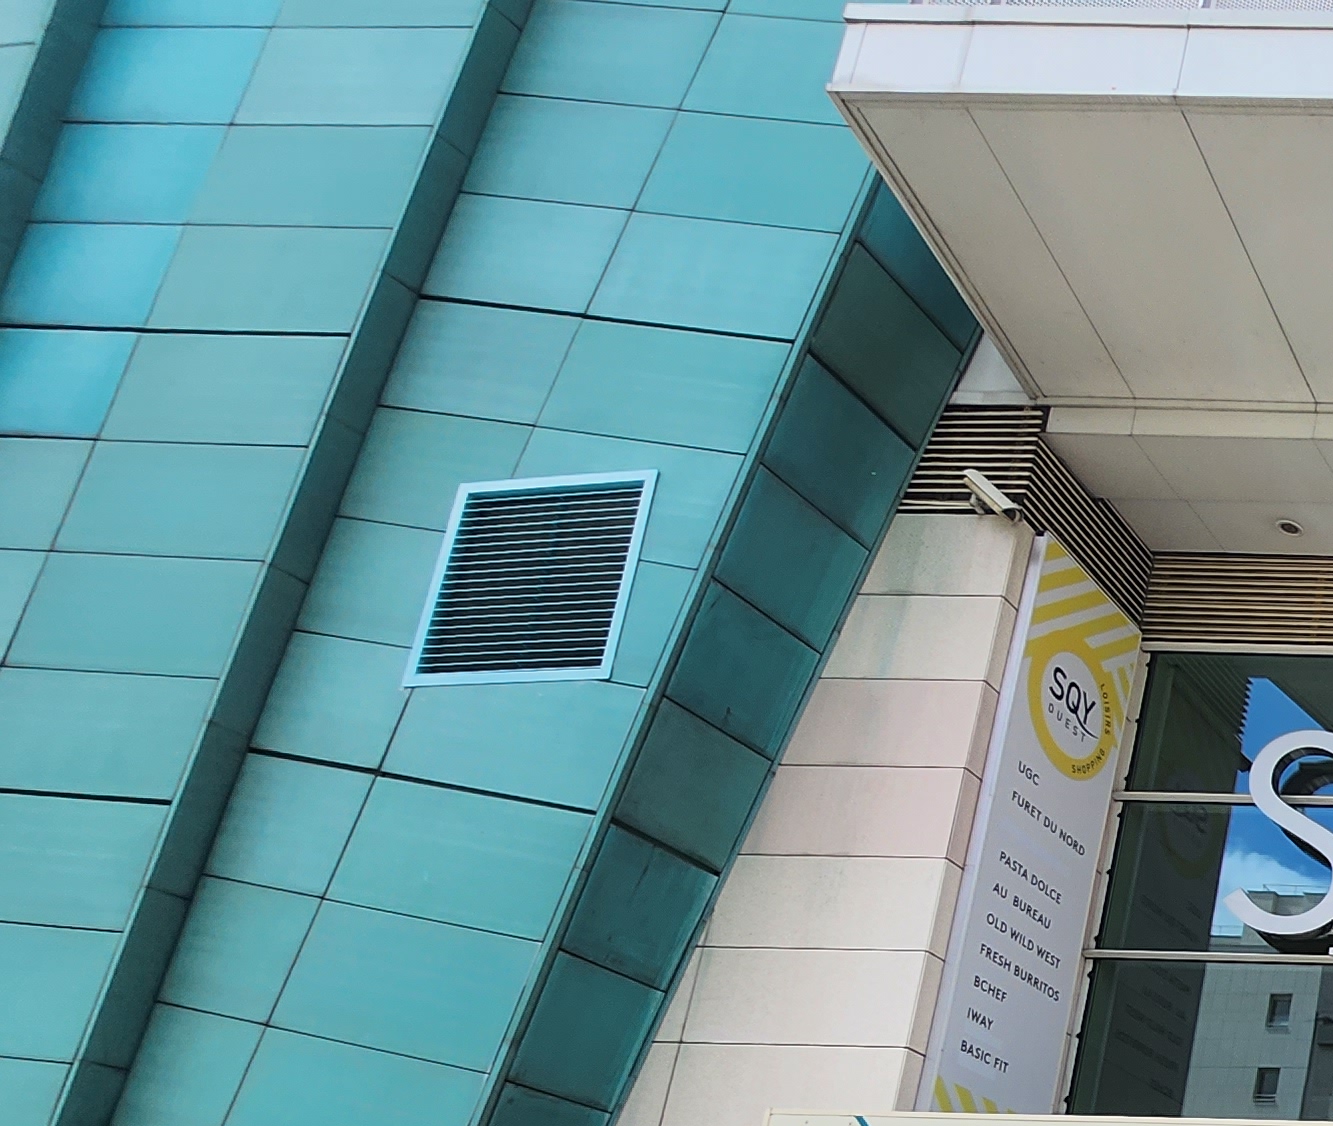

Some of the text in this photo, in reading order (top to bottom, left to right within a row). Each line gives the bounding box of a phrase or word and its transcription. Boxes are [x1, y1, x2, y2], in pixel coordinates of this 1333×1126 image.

[1048, 666, 1099, 740] SQY
[1048, 702, 1086, 742] OUEST
[1100, 683, 1112, 735] LOISIRS
[1018, 761, 1040, 787] UGC
[1071, 748, 1106, 774] SHOPPING
[1012, 790, 1085, 856] FURET DU NORD
[999, 851, 1062, 905] PASTA DOLCE
[992, 883, 1051, 929] AU BUREAU
[986, 913, 1061, 969] OLD WILD WEST
[973, 975, 1007, 1002] BCHEF
[979, 943, 1060, 1002] FRESH BURRITOS
[966, 1007, 994, 1030] IWAY
[960, 1040, 1009, 1073] BASIC FIT
